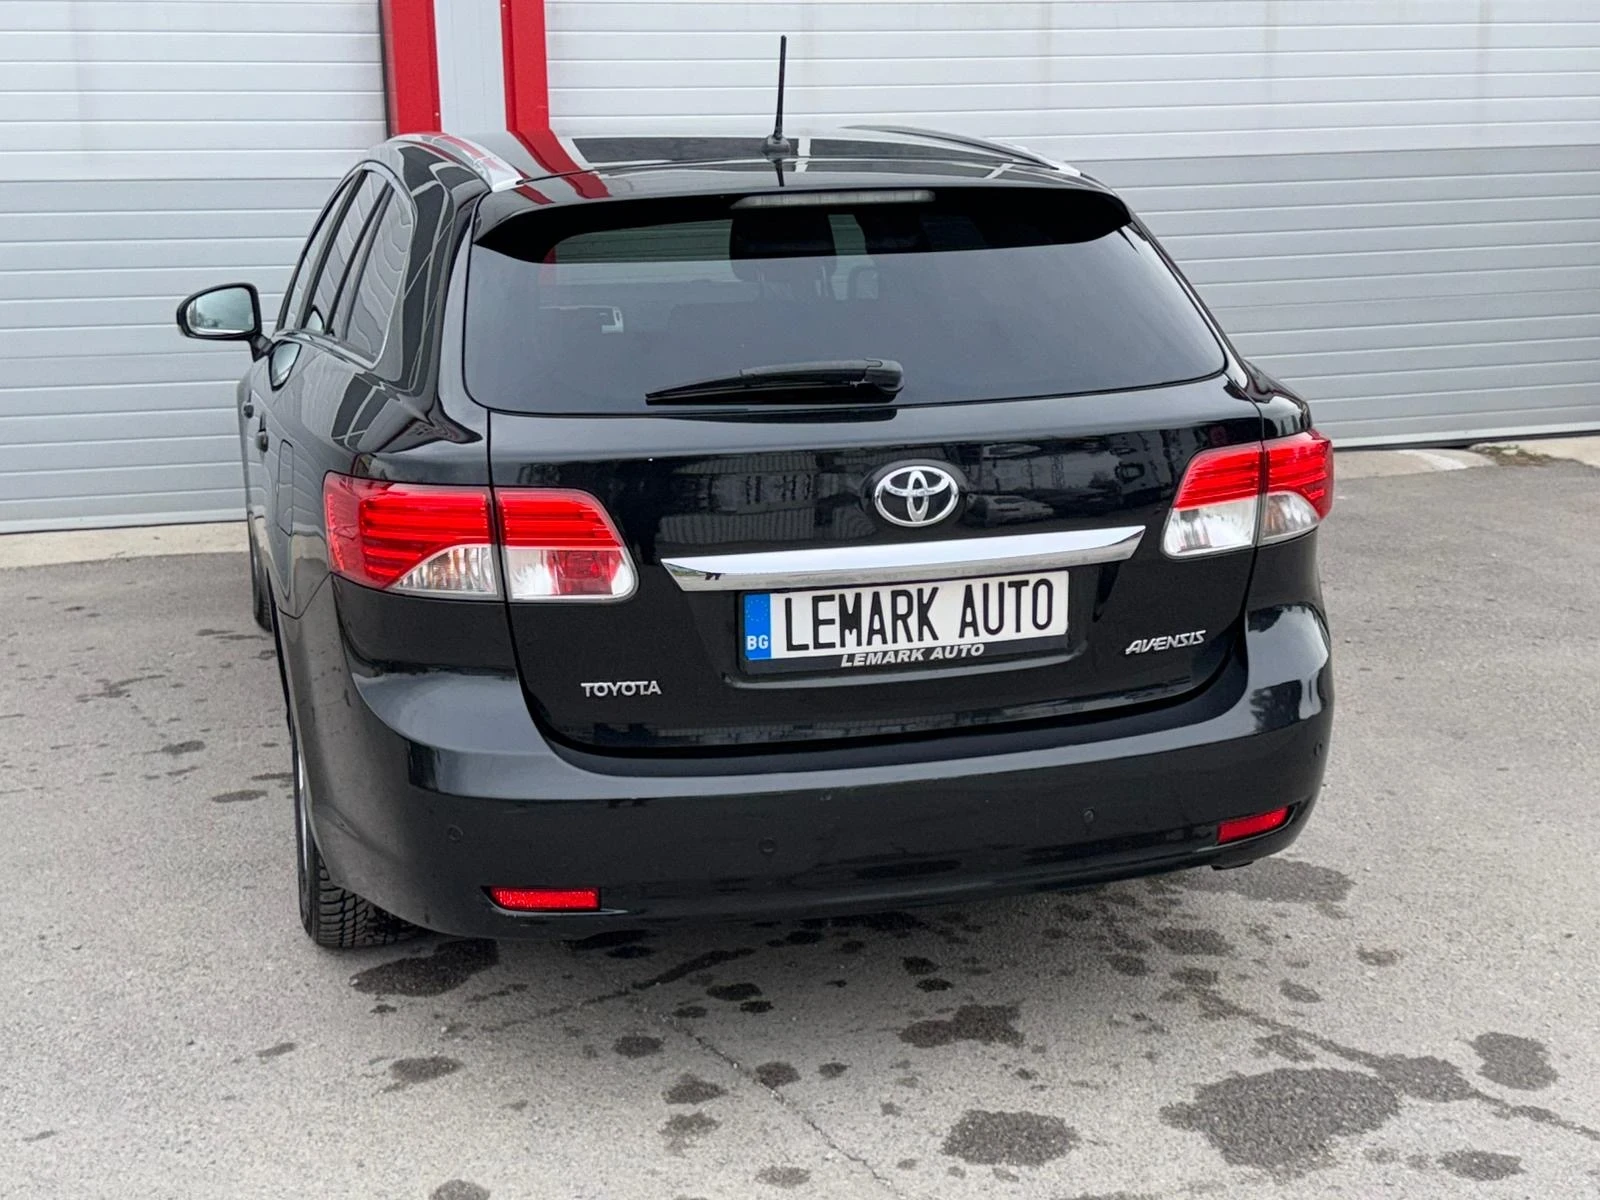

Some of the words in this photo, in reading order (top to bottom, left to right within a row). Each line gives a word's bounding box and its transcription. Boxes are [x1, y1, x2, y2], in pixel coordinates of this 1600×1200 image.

[785, 586, 939, 651] LEMARK
[958, 578, 1054, 638] AUTO
[746, 634, 769, 651] BG
[1125, 629, 1207, 655] AVENSIS
[841, 649, 925, 667] LEMARK
[931, 643, 985, 660] AUTO
[580, 680, 662, 698] TOYOTA
